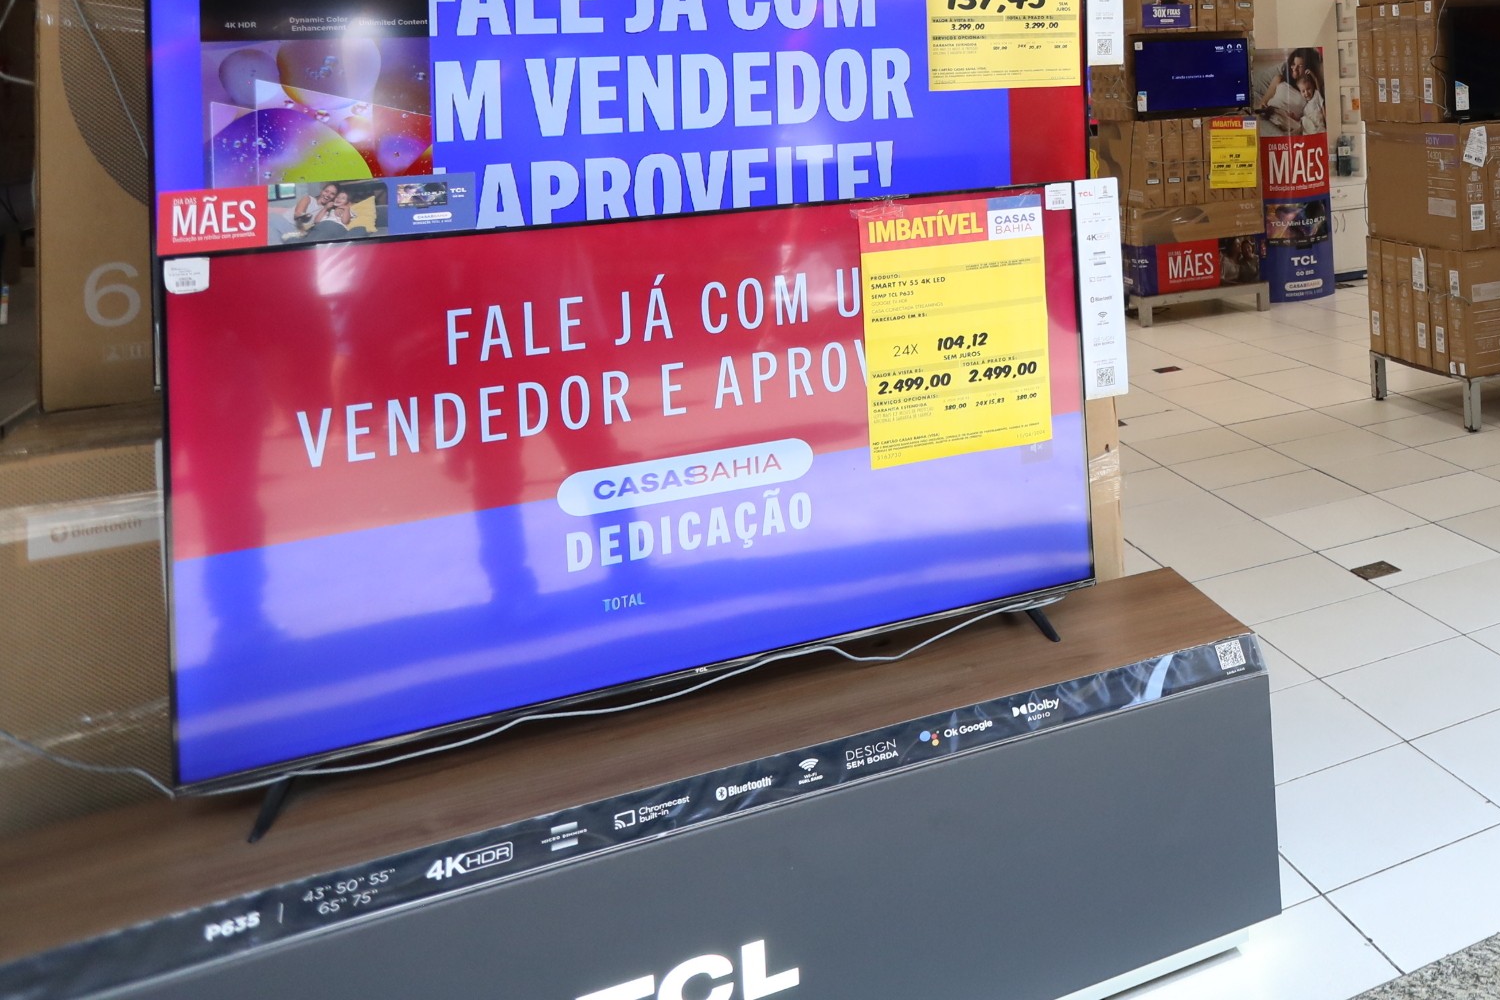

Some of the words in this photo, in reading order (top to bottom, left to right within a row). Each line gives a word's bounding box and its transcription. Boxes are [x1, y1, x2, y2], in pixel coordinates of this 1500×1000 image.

[238, 21, 257, 29] HDR
[289, 16, 325, 25] Dynamic
[326, 16, 348, 24] Color
[291, 24, 347, 32] Enhancement
[397, 18, 428, 26] Content
[951, 23, 985, 31] 3.299,00
[1024, 22, 1059, 30] 3.299,00
[434, 59, 503, 143] M
[524, 47, 914, 138] VENDEDOR
[1268, 142, 1324, 185] MÃES
[476, 140, 894, 230] APROVEITE!
[172, 195, 256, 237] MÃES
[994, 213, 1036, 225] CASAS
[868, 209, 984, 244] IMBATÍVEL
[995, 224, 1033, 235] BAHIA
[1168, 250, 1214, 280] MÃES
[1291, 255, 1317, 266] TCL
[871, 282, 896, 290] SMART
[933, 276, 946, 284] LED
[445, 296, 586, 366] FALE
[614, 273, 675, 347] JÁ
[701, 271, 809, 335] COM
[836, 267, 862, 319] U
[893, 343, 919, 357] 24X
[937, 332, 988, 351] 104,12
[943, 353, 958, 361] SEM
[960, 351, 981, 359] JUROS
[877, 373, 951, 395] 2.499,00
[968, 361, 1037, 383] 2.499,00
[296, 370, 632, 469] VENDEDOR
[661, 362, 687, 417] E
[565, 486, 813, 573] DEDICAÇÃO
[602, 591, 646, 613] TOTAL
[1027, 698, 1060, 713] Dolby
[1027, 711, 1051, 722] AUDIO
[943, 727, 958, 738] Ok
[959, 719, 993, 737] Google
[845, 738, 897, 761] DESIGN
[846, 758, 865, 770] SEM
[867, 750, 899, 766] BORDA
[727, 775, 771, 797] Bluetooth
[638, 795, 690, 816] Chromecast
[639, 808, 670, 823] built-in
[204, 911, 261, 942] P635
